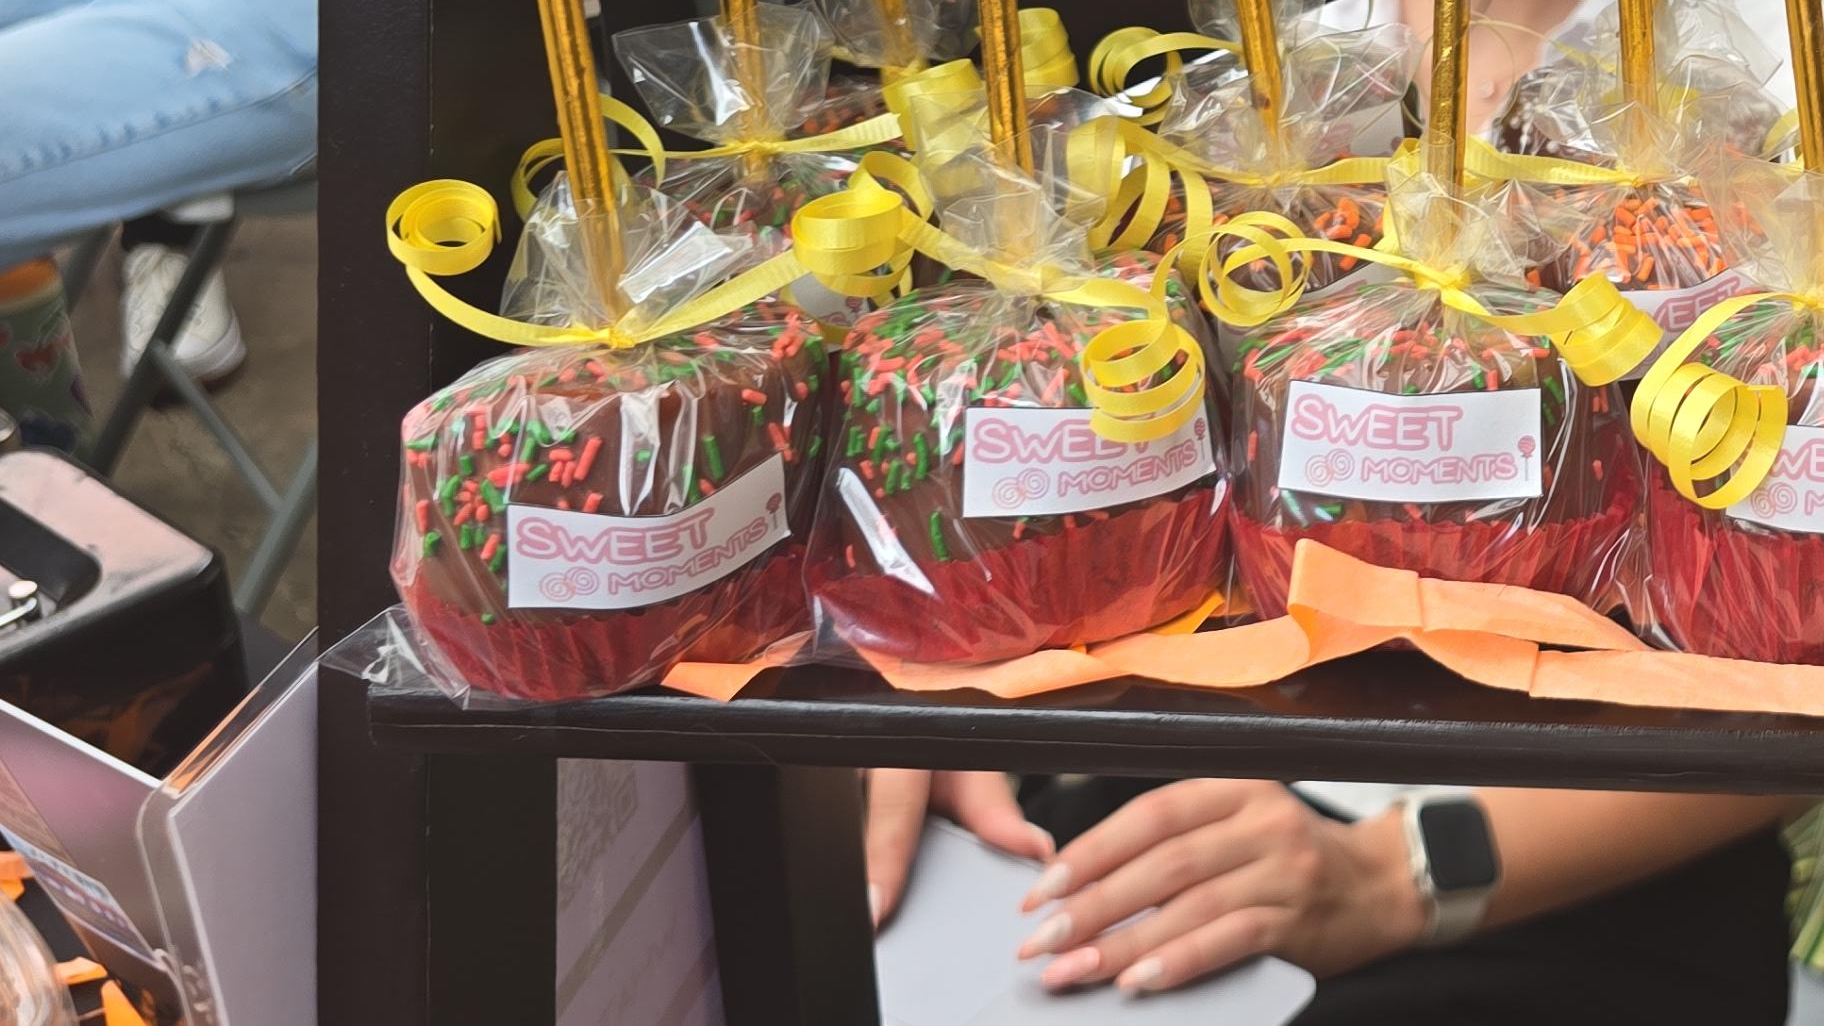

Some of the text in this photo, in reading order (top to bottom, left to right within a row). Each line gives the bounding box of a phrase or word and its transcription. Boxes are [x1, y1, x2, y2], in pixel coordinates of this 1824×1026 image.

[1291, 394, 1464, 451] SWEET
[1058, 438, 1198, 497] MOMENTS
[1360, 452, 1519, 485] MOMENTS
[516, 507, 704, 565] SWEET
[608, 516, 768, 594] MOMENTS
